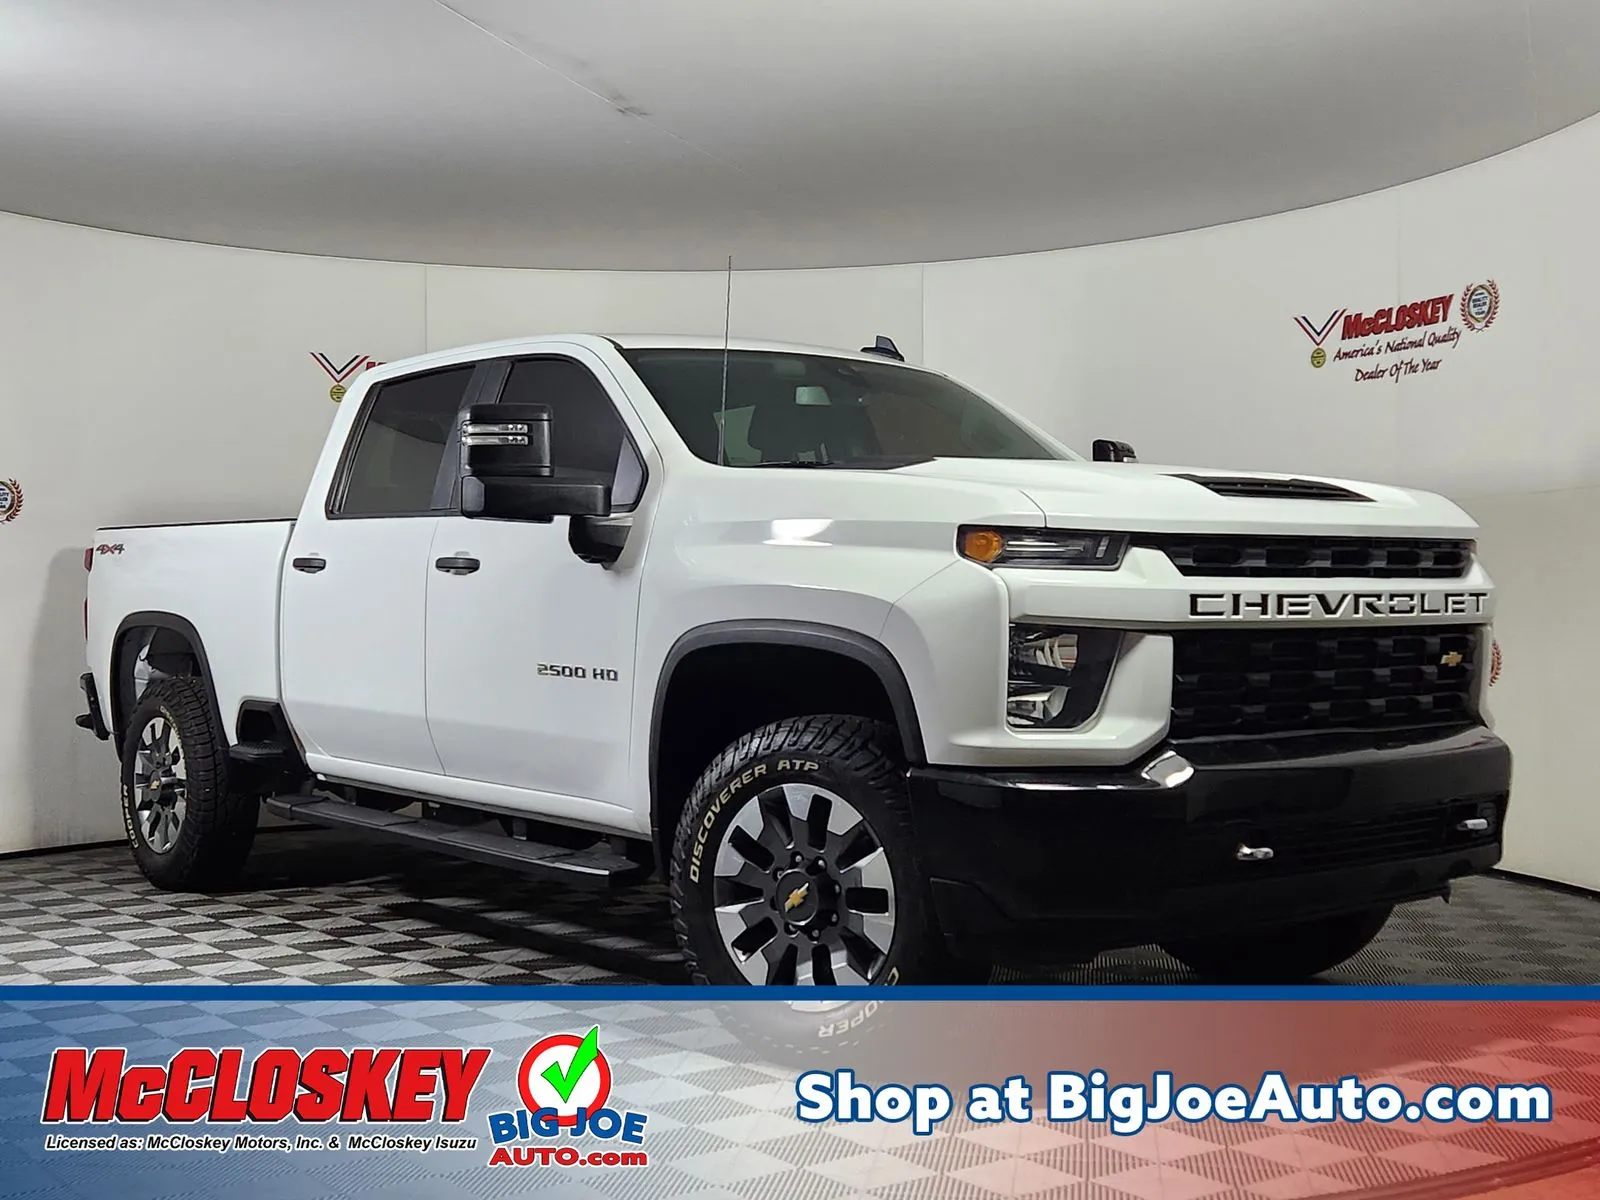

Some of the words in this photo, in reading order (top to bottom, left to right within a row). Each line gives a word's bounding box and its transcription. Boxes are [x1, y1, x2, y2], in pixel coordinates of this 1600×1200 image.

[1341, 294, 1454, 340] McCLOSKEY
[1333, 340, 1382, 362] America's
[1384, 331, 1428, 354] National
[1427, 326, 1461, 349] Quality
[1355, 363, 1388, 382] Dealer
[1389, 359, 1404, 383] Of
[1402, 358, 1418, 375] The
[1420, 358, 1442, 373] Year
[1188, 592, 1488, 618] CHEVROLET
[537, 663, 586, 678] 2500
[592, 667, 618, 681] HD
[689, 764, 767, 883] DISCOVERER
[777, 759, 819, 770] ATP
